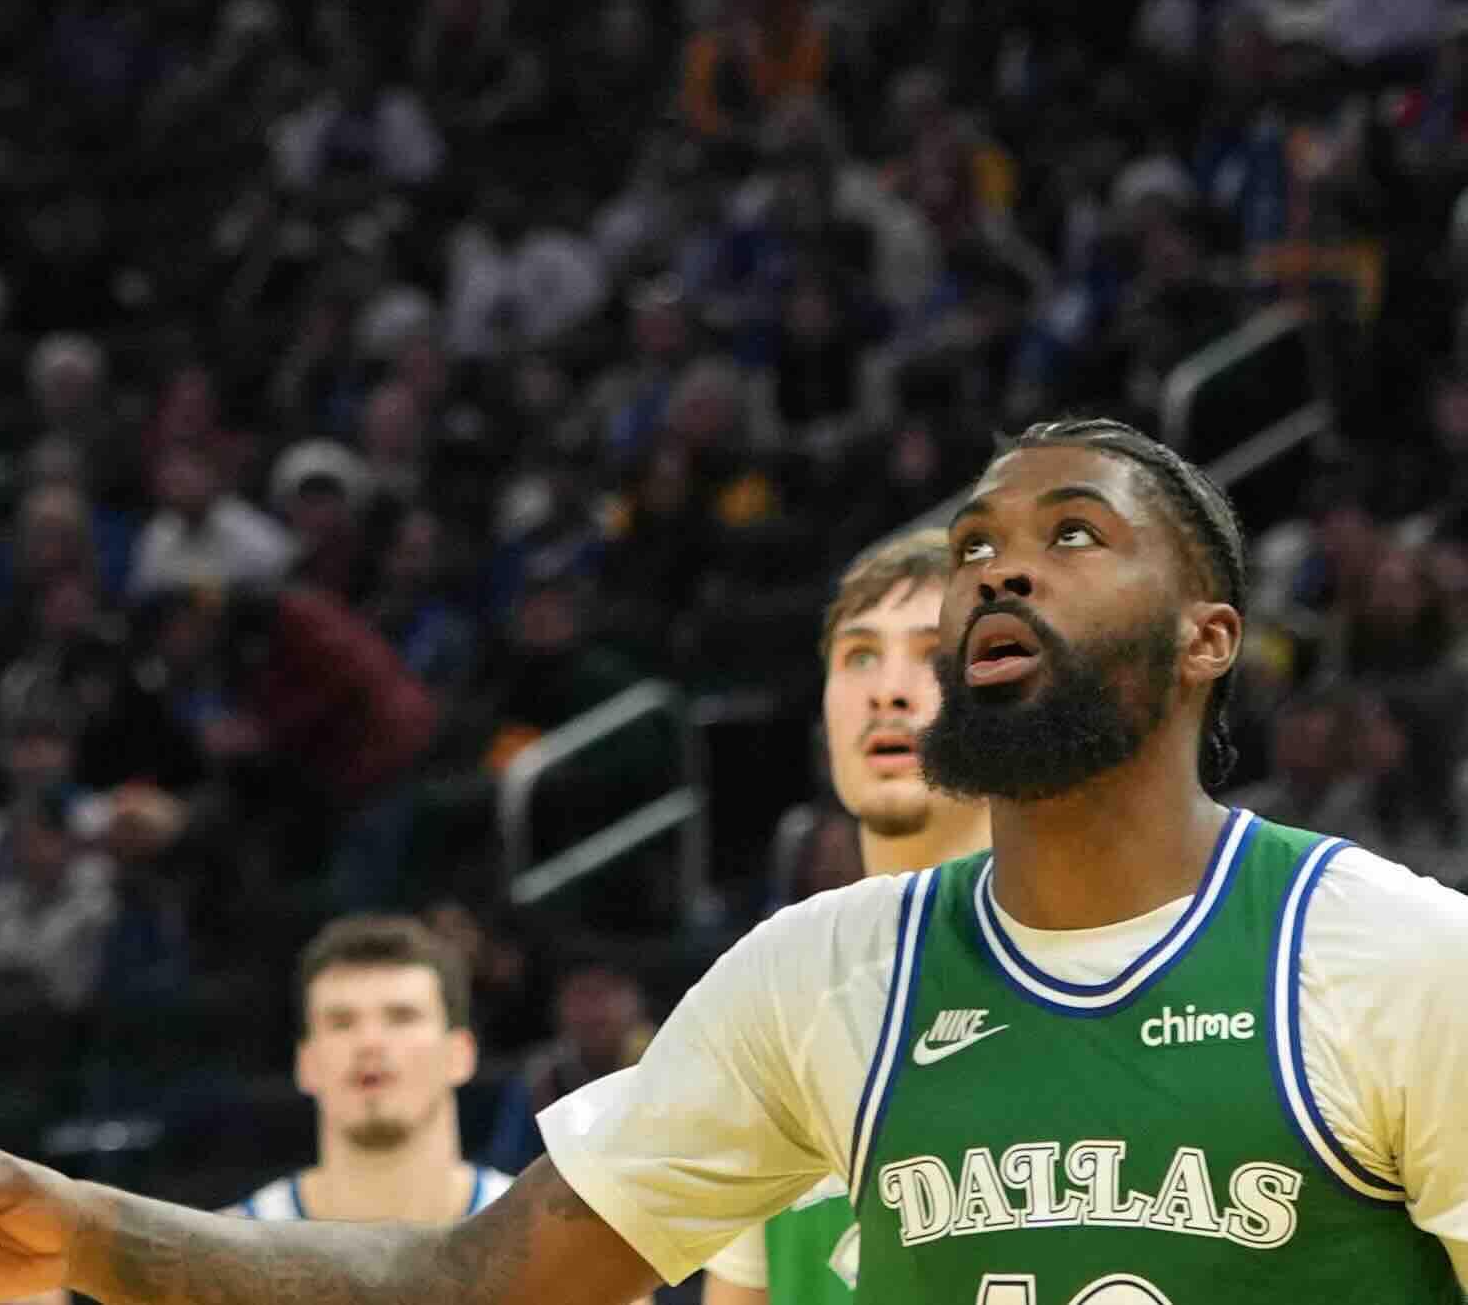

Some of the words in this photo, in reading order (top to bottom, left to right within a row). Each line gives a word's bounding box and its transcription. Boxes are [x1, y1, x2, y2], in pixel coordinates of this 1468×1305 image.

[928, 1009, 990, 1042] NIKE
[1140, 1005, 1256, 1048] chime
[879, 1140, 1303, 1249] DALLAS
